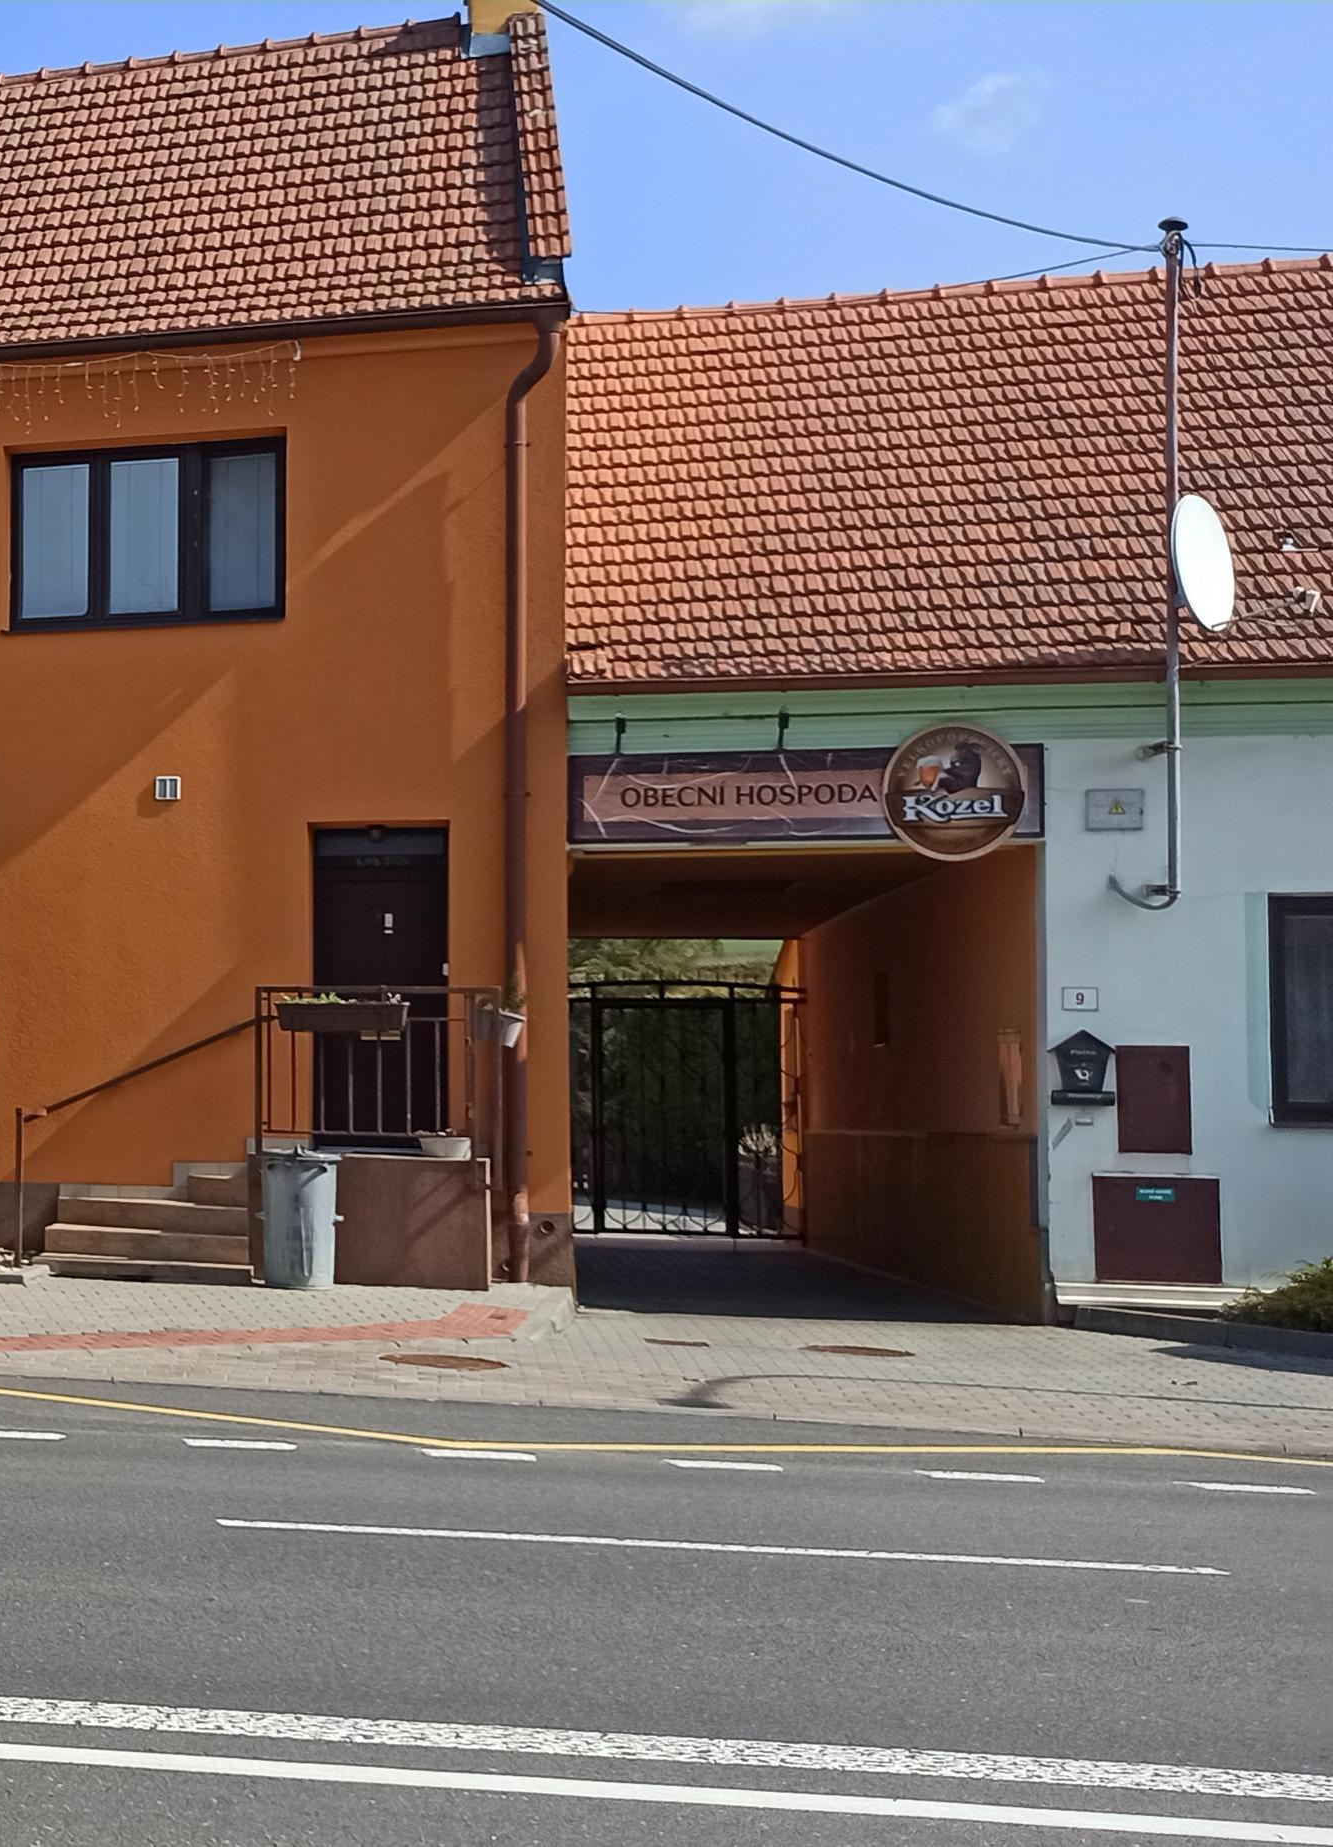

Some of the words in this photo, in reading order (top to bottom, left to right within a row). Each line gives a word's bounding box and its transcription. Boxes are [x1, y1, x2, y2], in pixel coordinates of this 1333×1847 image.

[619, 780, 725, 809] OBECNÍ
[735, 783, 878, 807] HOSPODA
[901, 793, 1008, 822] Kozel
[1075, 992, 1085, 1006] 9
